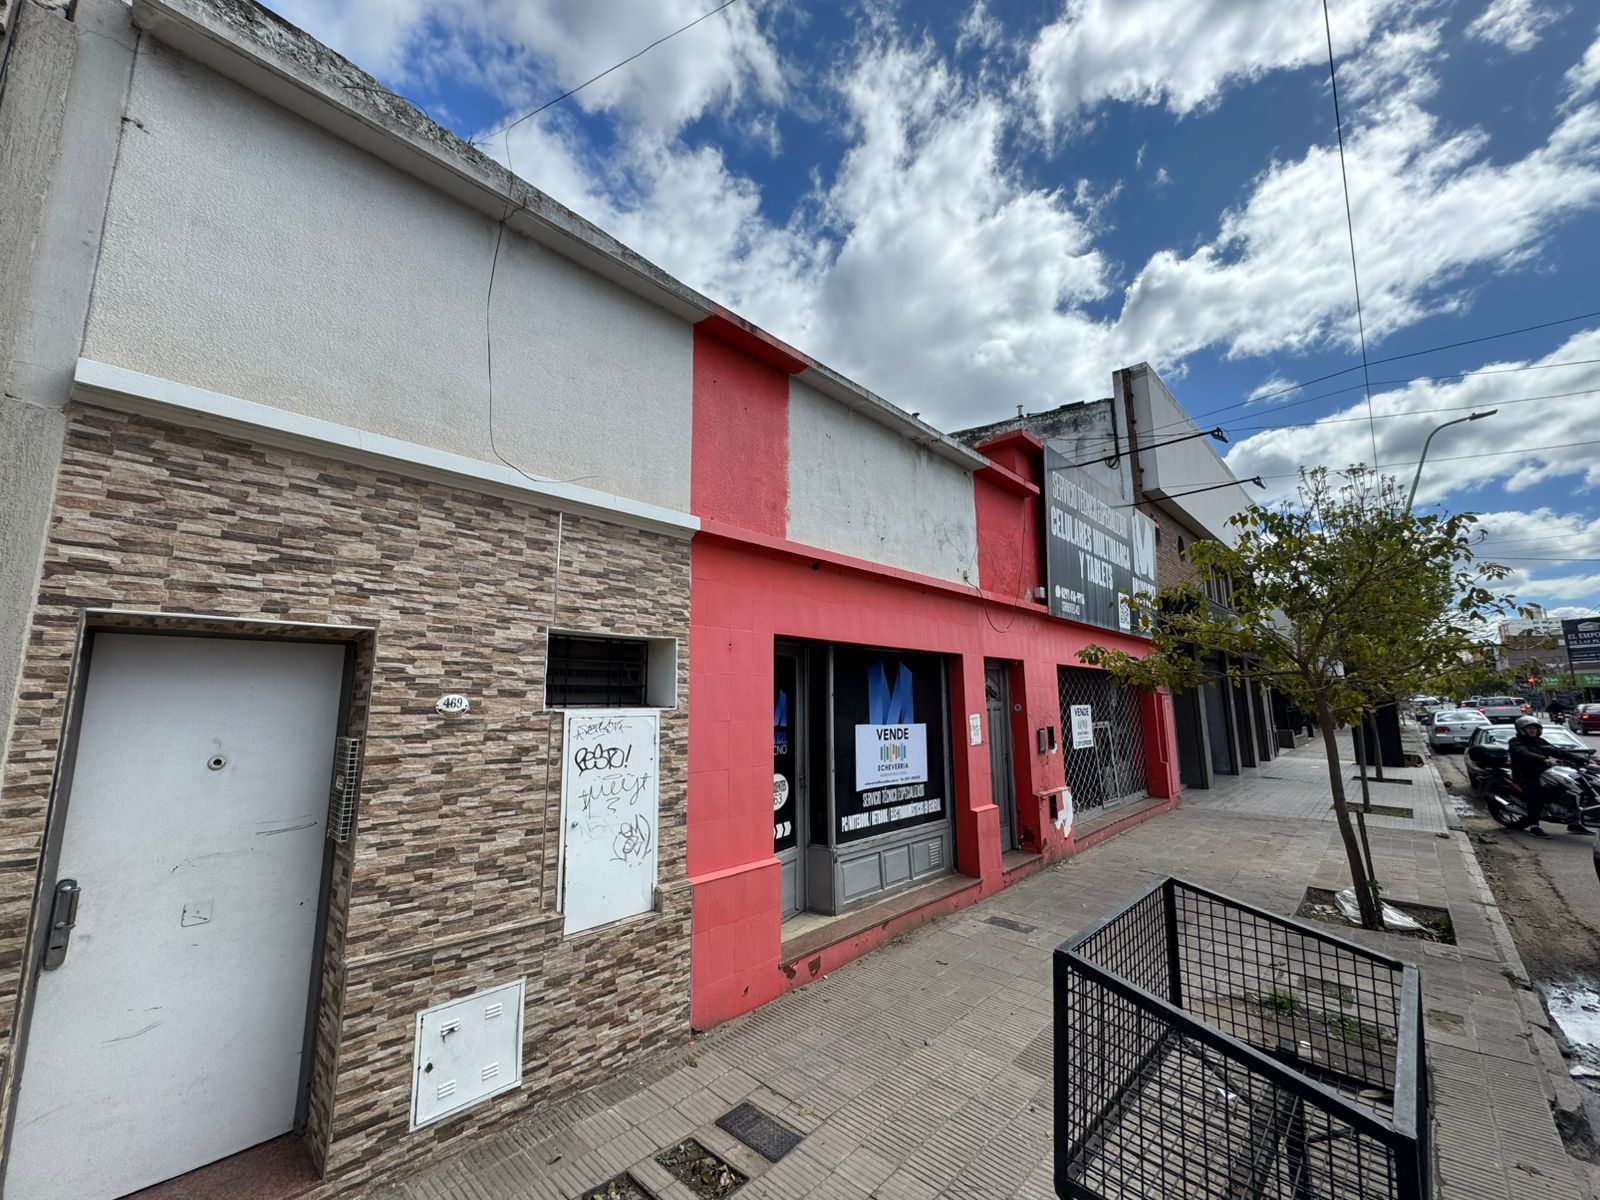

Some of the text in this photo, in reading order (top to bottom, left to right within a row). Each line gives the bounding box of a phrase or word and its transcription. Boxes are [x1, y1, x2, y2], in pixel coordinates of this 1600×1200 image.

[1050, 504, 1131, 571] CELULARES MULTIMARCA
[1079, 550, 1113, 590] Y TABLETS
[443, 697, 463, 709] 469
[1074, 706, 1090, 717] VENDE
[876, 727, 909, 741] VENDE
[877, 762, 909, 772] ECHEVERRIA
